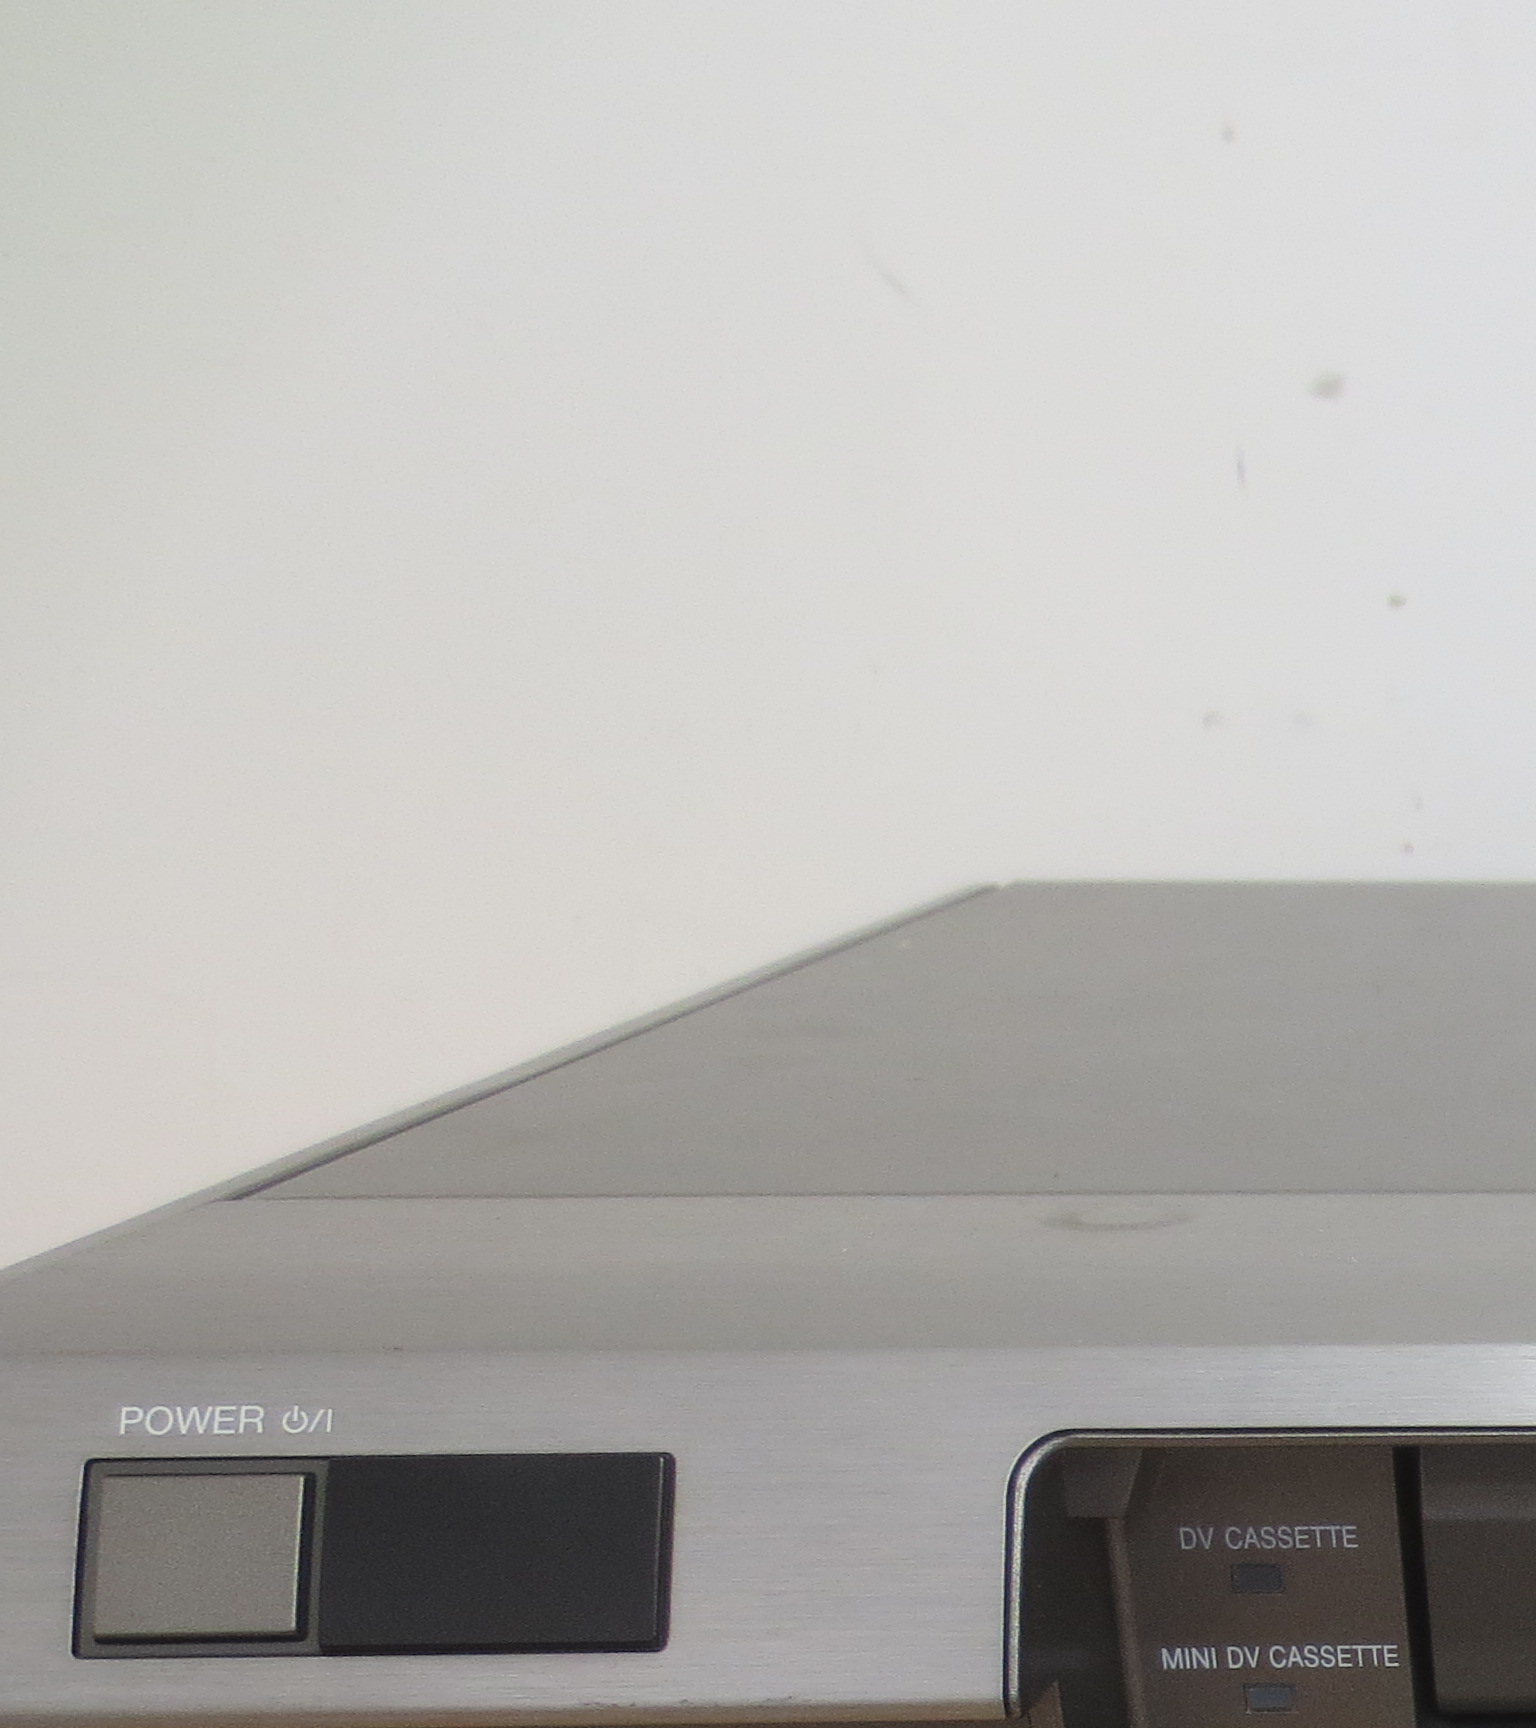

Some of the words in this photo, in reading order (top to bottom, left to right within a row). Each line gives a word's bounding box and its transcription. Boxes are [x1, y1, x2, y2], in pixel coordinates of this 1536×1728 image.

[119, 1406, 265, 1435] POWER
[1179, 1527, 1214, 1550] DV
[1225, 1526, 1359, 1549] CASSETTE
[1161, 1647, 1217, 1670] MINI
[1227, 1646, 1260, 1669] DV
[1268, 1645, 1399, 1668] CASSETTE
